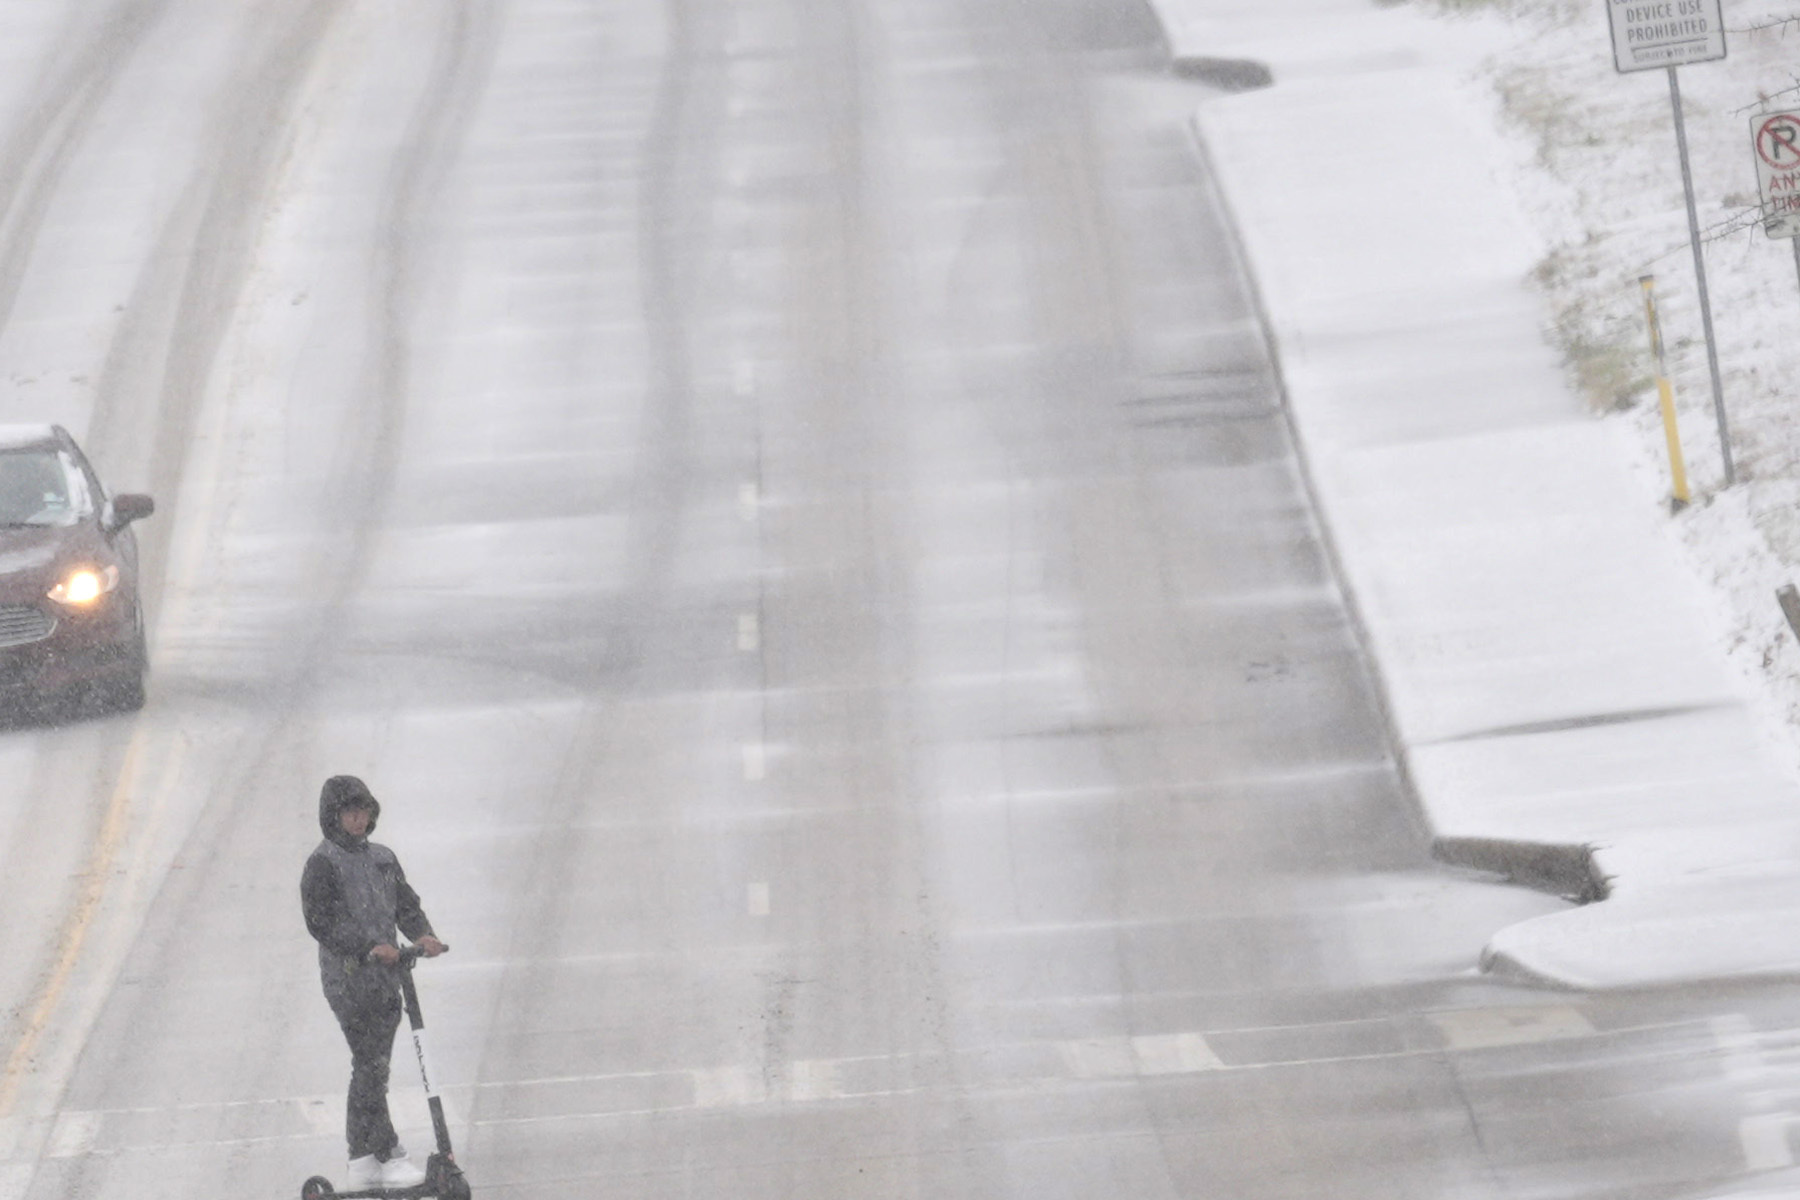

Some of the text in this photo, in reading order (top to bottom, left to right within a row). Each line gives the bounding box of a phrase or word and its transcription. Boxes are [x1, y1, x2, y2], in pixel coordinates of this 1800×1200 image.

[1626, 0, 1703, 23] DEVICE USE
[1627, 18, 1708, 42] PROHIBITED
[1769, 171, 1800, 192] AN
